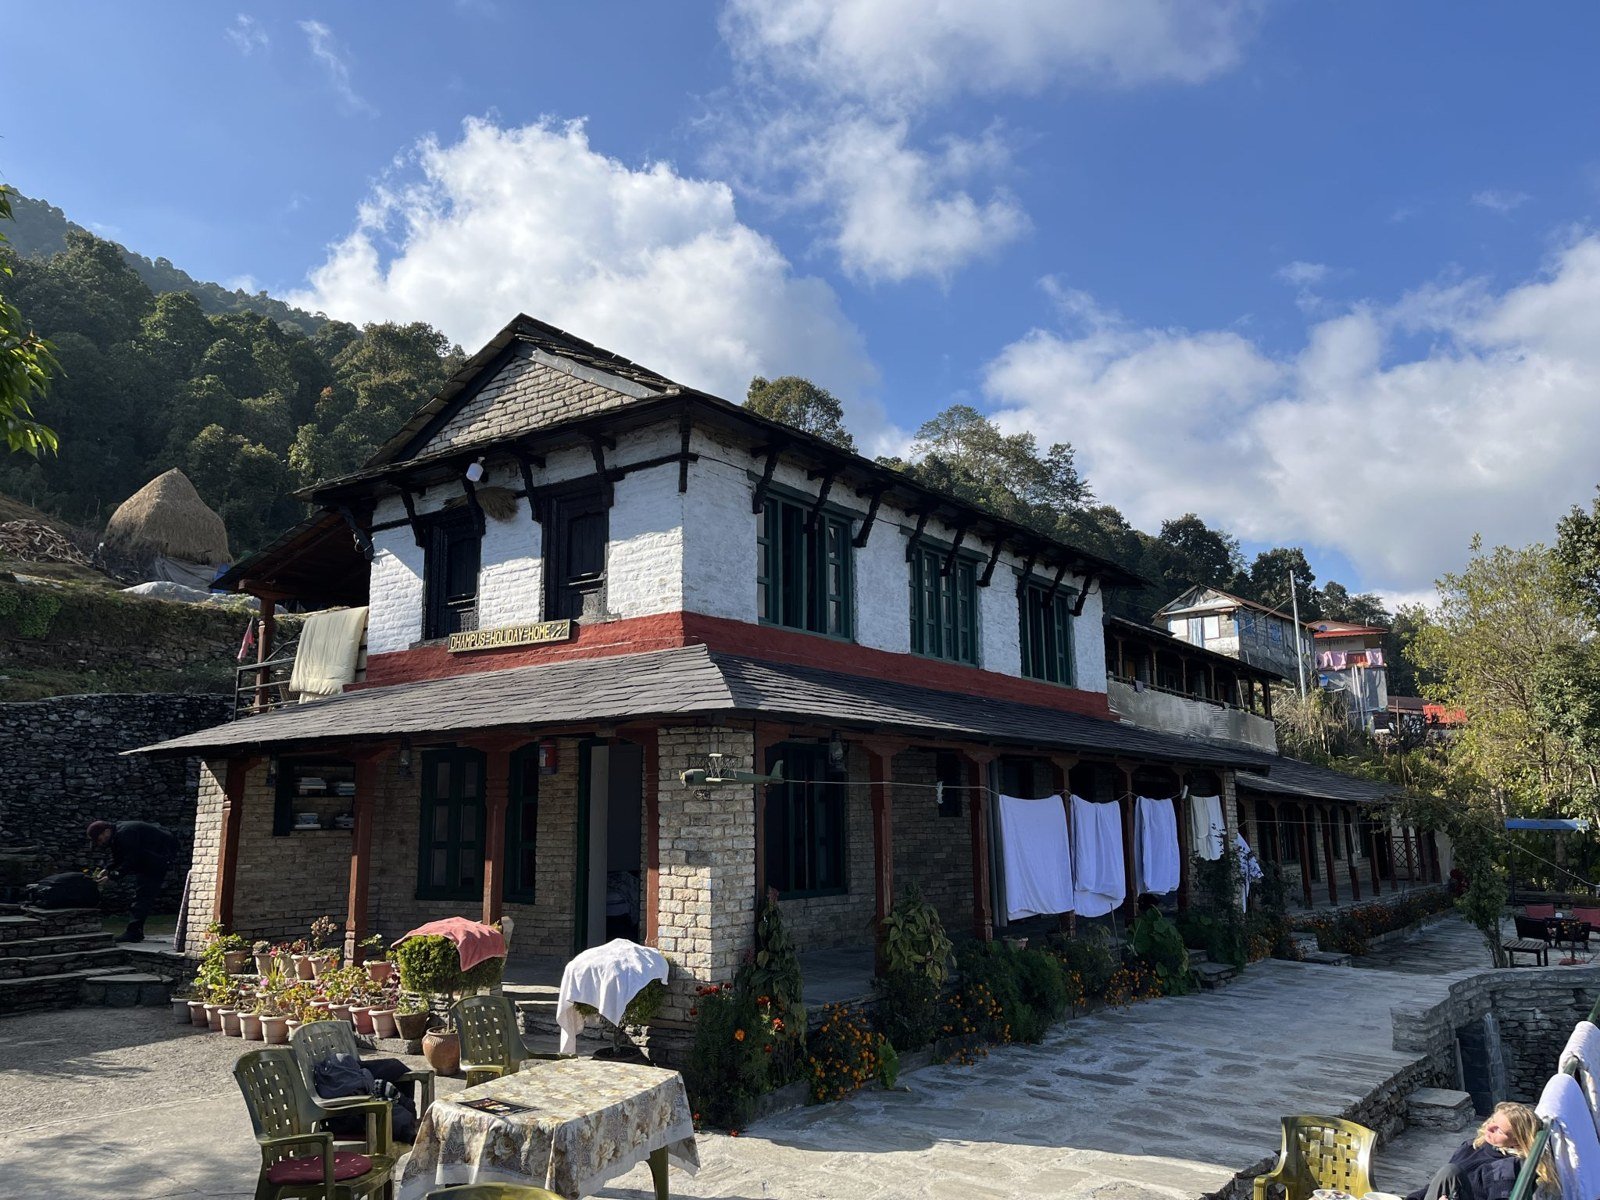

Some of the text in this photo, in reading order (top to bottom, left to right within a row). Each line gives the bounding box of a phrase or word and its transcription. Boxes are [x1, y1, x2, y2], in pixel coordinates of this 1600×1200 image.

[450, 624, 551, 650] DHAMPUS HOLIDAY HOME
